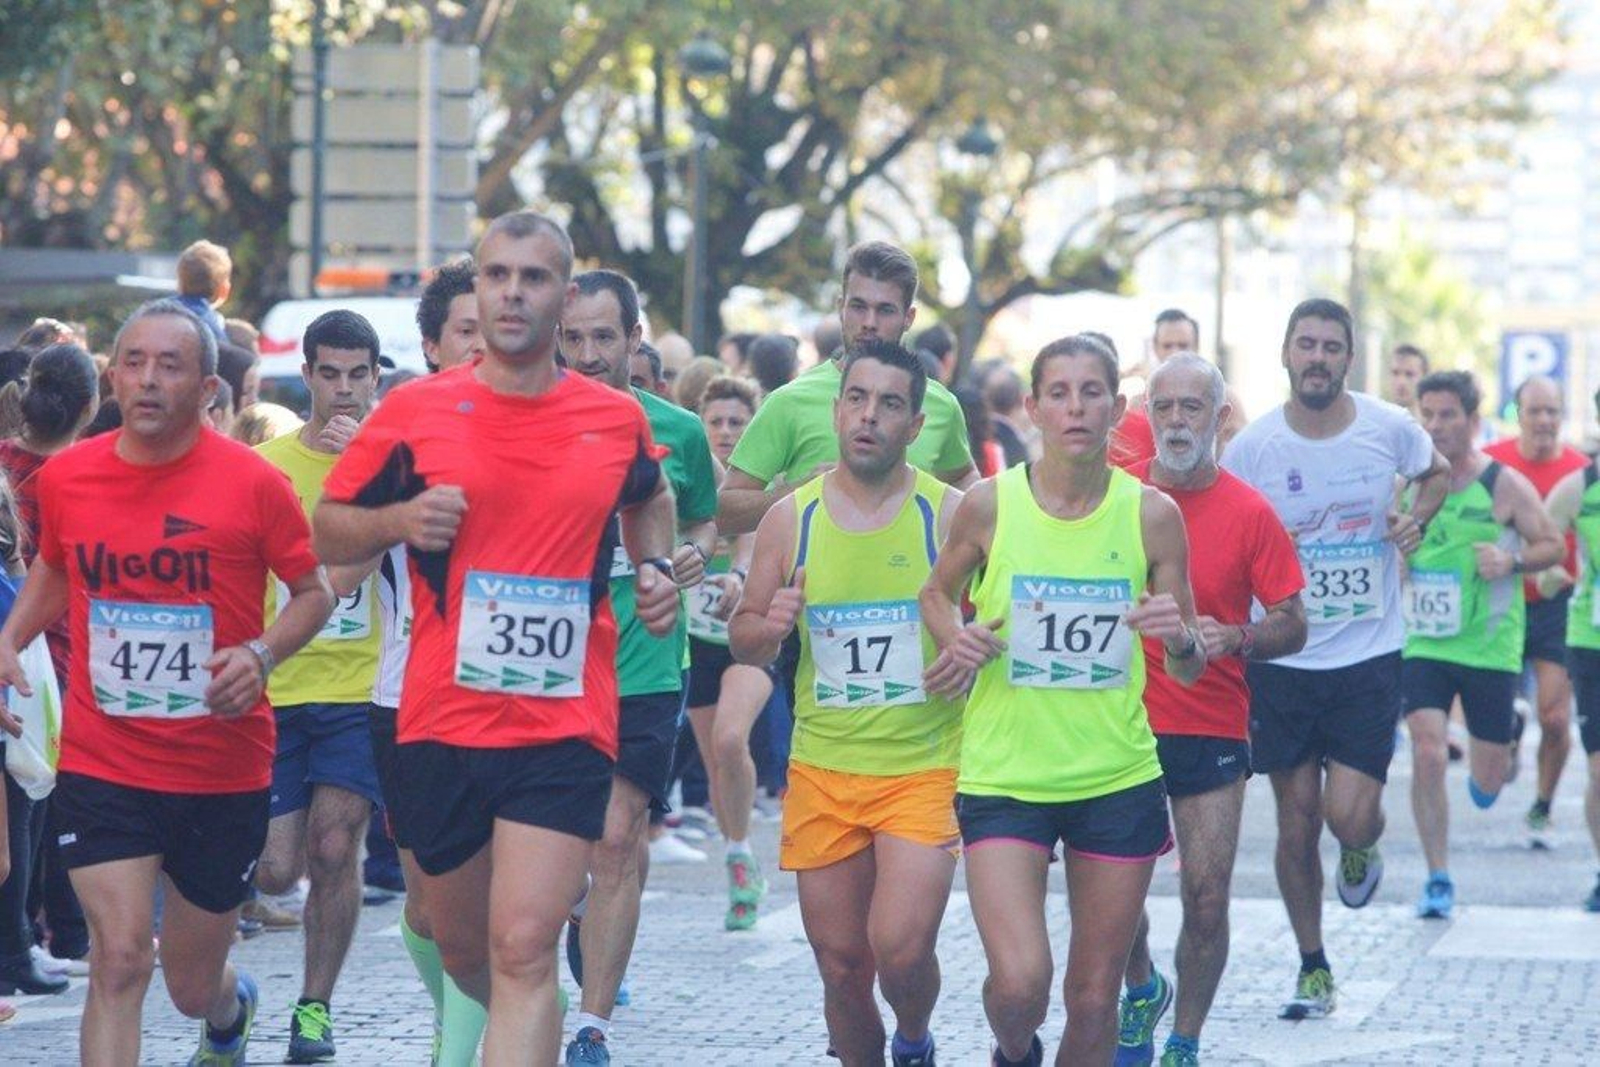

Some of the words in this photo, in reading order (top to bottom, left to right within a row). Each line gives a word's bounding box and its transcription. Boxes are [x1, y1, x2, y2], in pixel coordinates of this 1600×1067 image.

[1510, 336, 1557, 398] P
[1310, 567, 1371, 599] 333
[1411, 591, 1451, 616] 165
[486, 613, 575, 660] 350
[1037, 612, 1121, 654] 167
[109, 640, 197, 682] 474
[843, 634, 893, 675] 17
